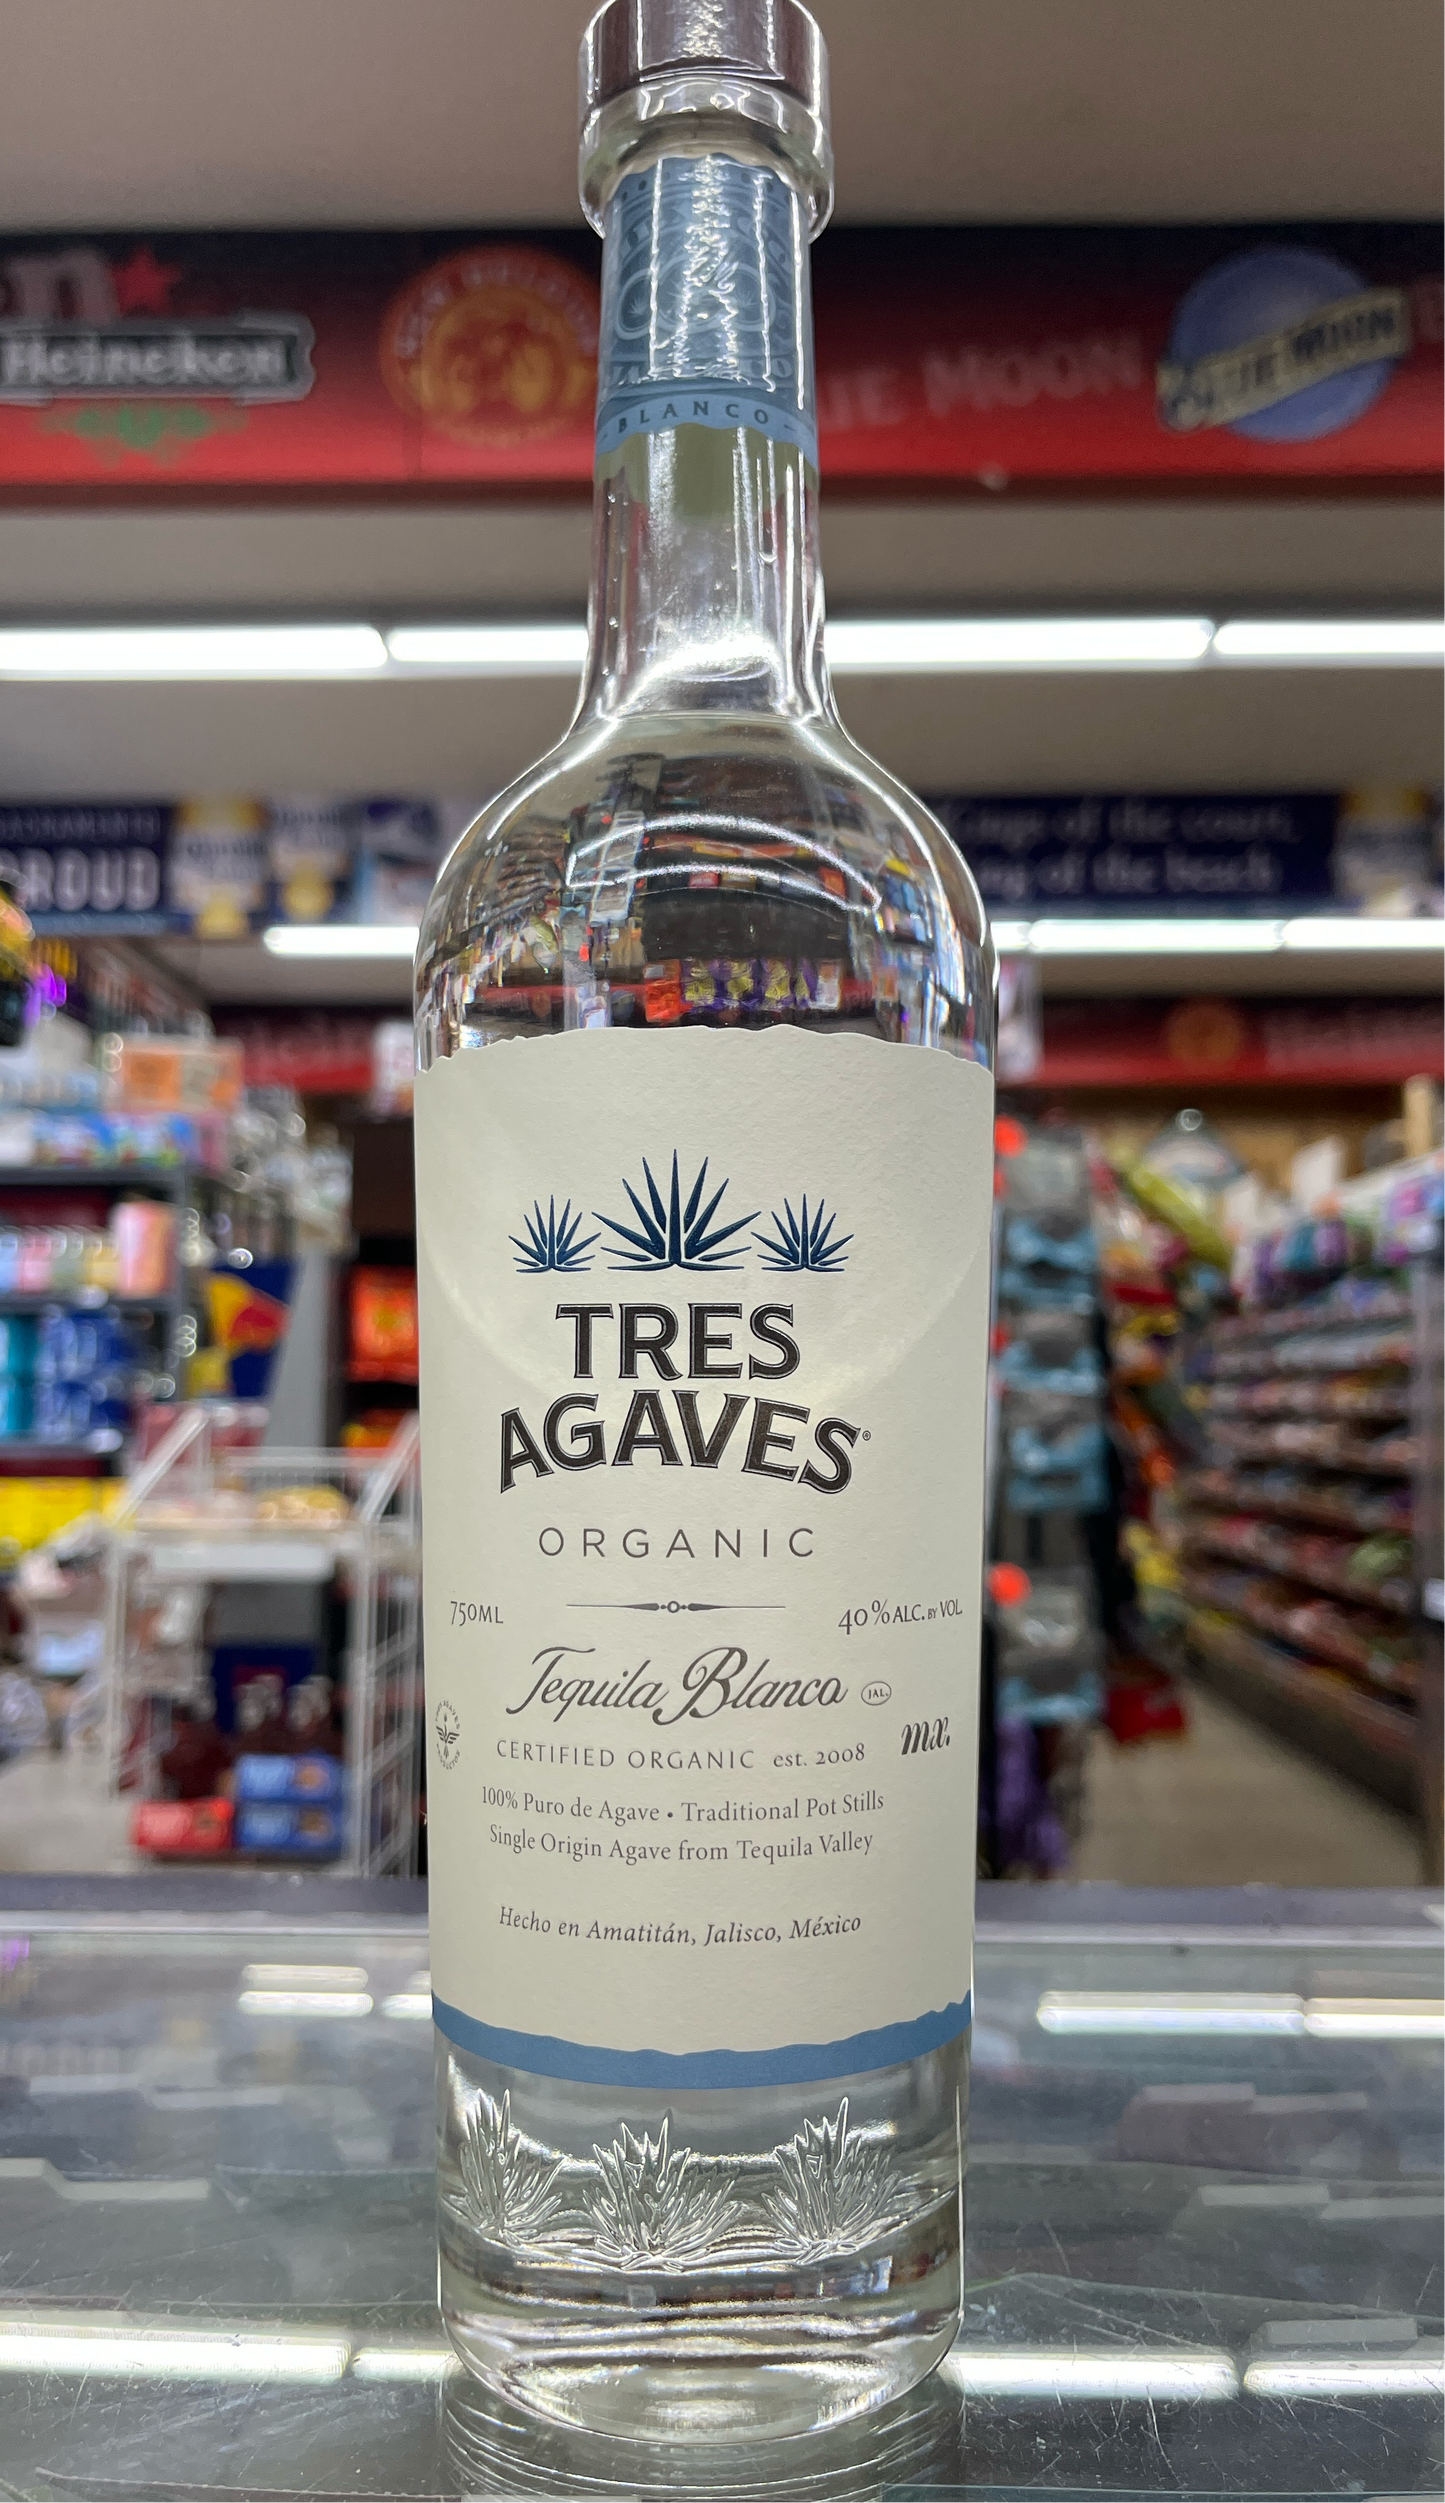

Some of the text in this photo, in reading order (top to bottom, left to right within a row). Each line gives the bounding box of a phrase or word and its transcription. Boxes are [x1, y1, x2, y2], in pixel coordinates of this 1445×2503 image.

[3, 330, 286, 386] Heineken
[924, 340, 1143, 418] MOON
[618, 400, 769, 434] BLANCO
[556, 1303, 801, 1381] TRES
[500, 1389, 862, 1495] AGAVES
[538, 1527, 815, 1559] ORGANIC
[450, 1600, 504, 1627] 750ML
[838, 1599, 891, 1636] 40%
[892, 1604, 925, 1624] ALC.
[939, 1599, 963, 1617] VOL
[505, 1646, 849, 1726] Tequila Blanco
[496, 1739, 866, 1769] CERTIFIED ORGANIC est. 2008
[482, 1785, 884, 1827] 100% Puro de Agave Traditional Pot Stills
[490, 1823, 874, 1866] Single Origin Agave from Tequila Valley
[499, 1905, 862, 1947] Hecho en Amatitán, Jalisco, México
